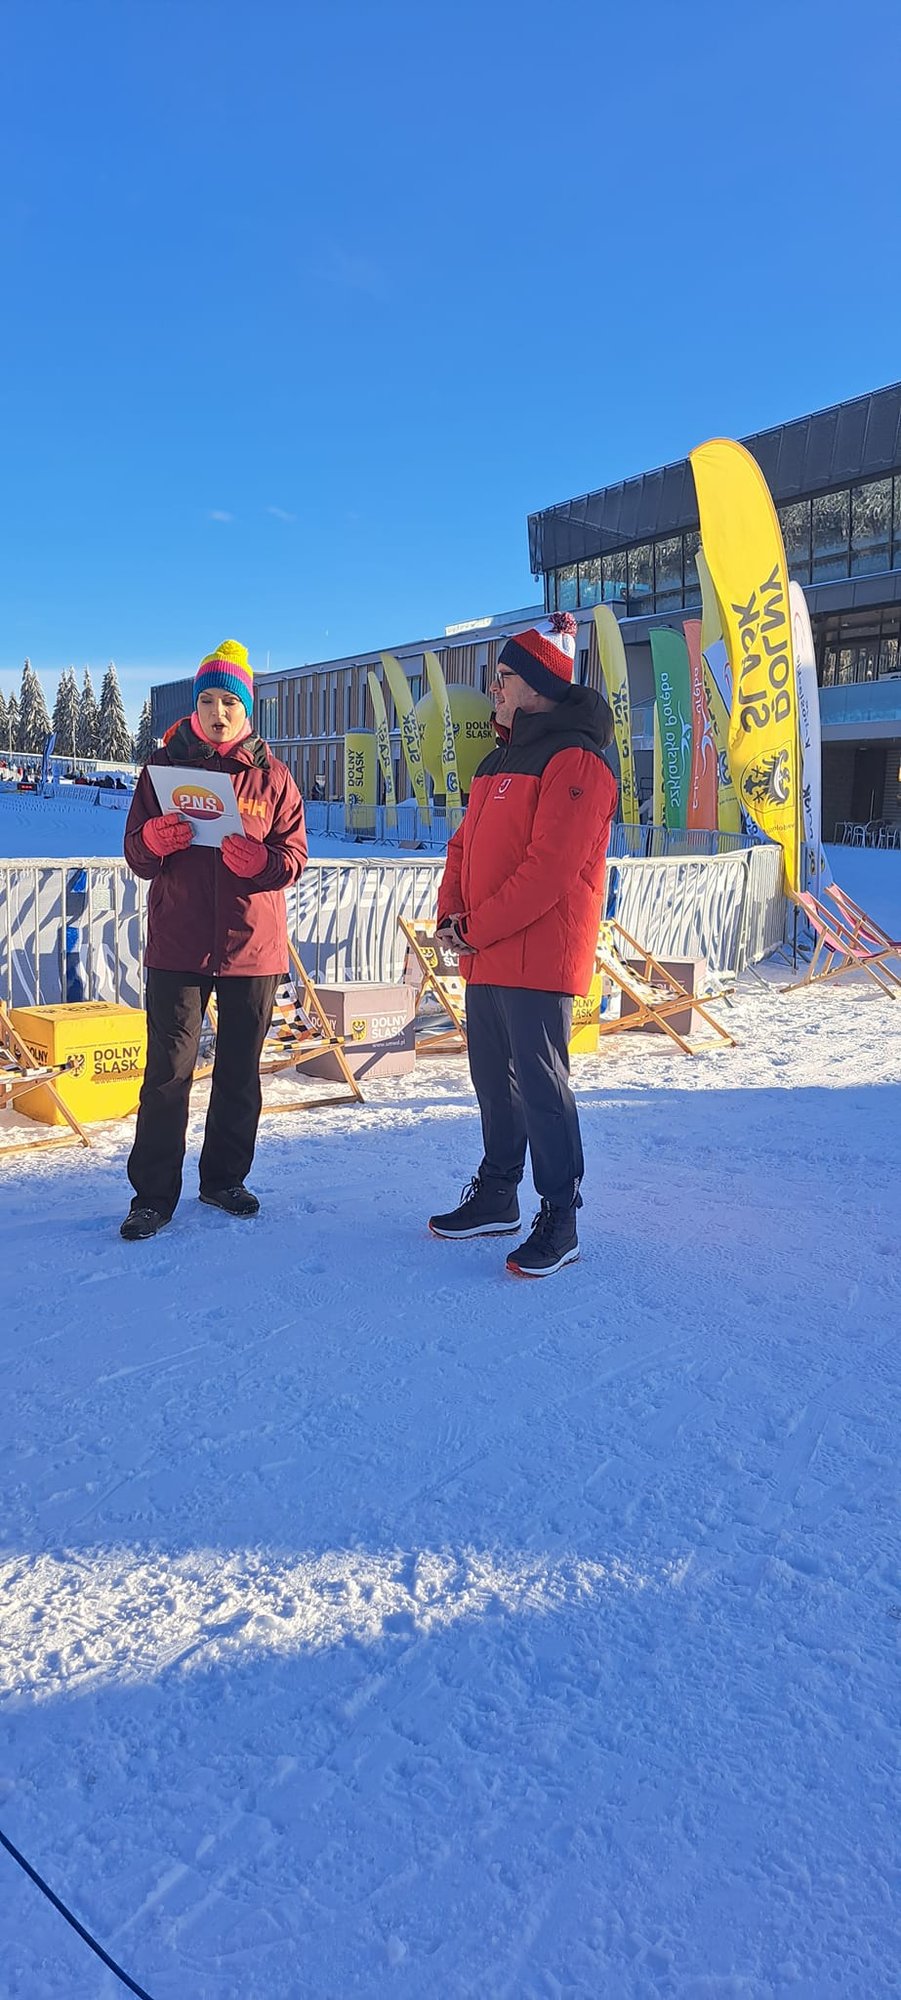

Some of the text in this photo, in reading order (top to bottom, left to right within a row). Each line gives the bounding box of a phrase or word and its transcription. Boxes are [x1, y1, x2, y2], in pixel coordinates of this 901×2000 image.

[239, 797, 267, 818] HH
[371, 1015, 407, 1029] DOLNY
[94, 1046, 141, 1061] DOLNY
